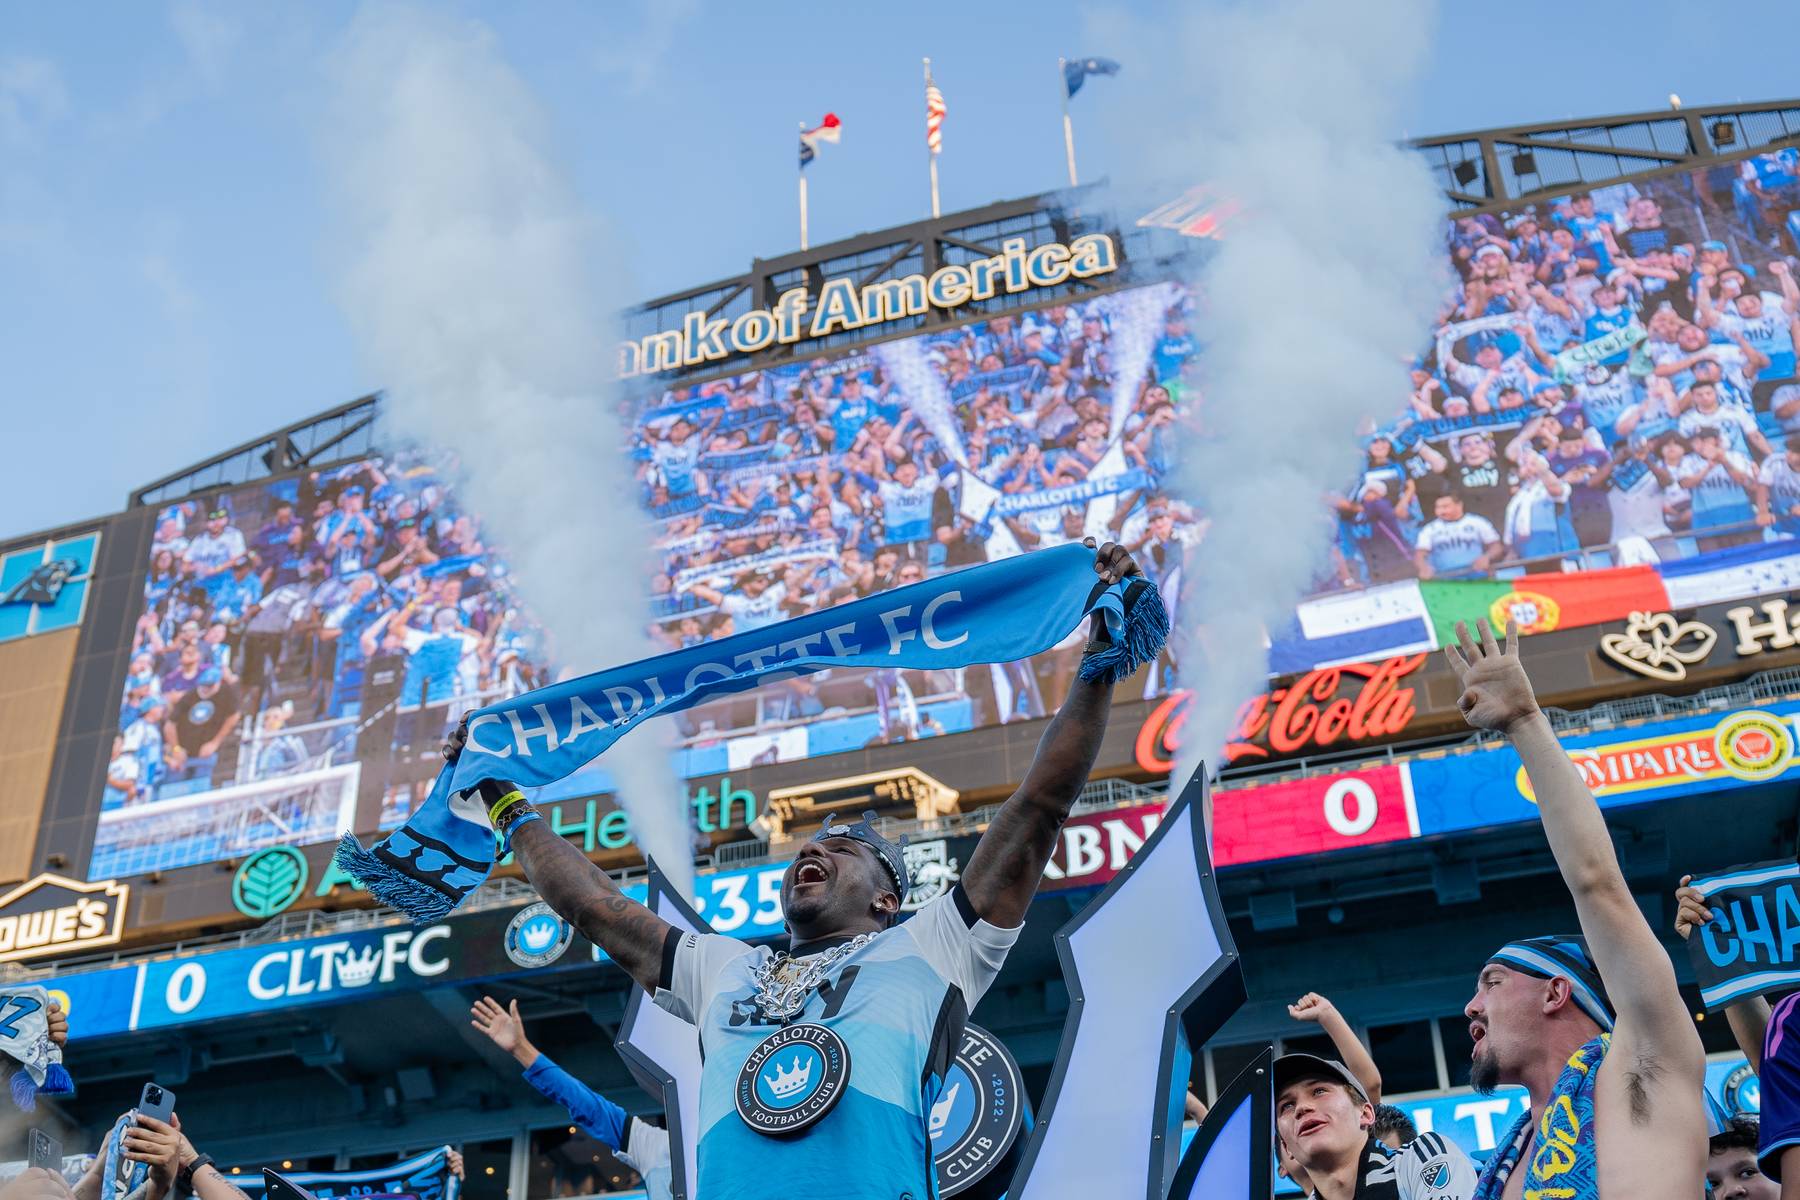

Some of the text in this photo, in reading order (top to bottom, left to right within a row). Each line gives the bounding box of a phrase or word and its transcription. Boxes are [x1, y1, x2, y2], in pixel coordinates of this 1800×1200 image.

[879, 590, 969, 656] FC
[1726, 598, 1800, 656] H
[1135, 652, 1428, 773] Ca-Cola
[552, 777, 757, 853] Heth
[1323, 777, 1378, 836] 0
[0, 897, 108, 952] OWE'S
[165, 961, 207, 1015] 0
[745, 1026, 829, 1074] CHARLOTTE
[962, 1034, 993, 1067] TE
[751, 1081, 835, 1126] FOOTBALL CLUB
[946, 1136, 993, 1178] CLUB
[1422, 1166, 1438, 1179] MLS
